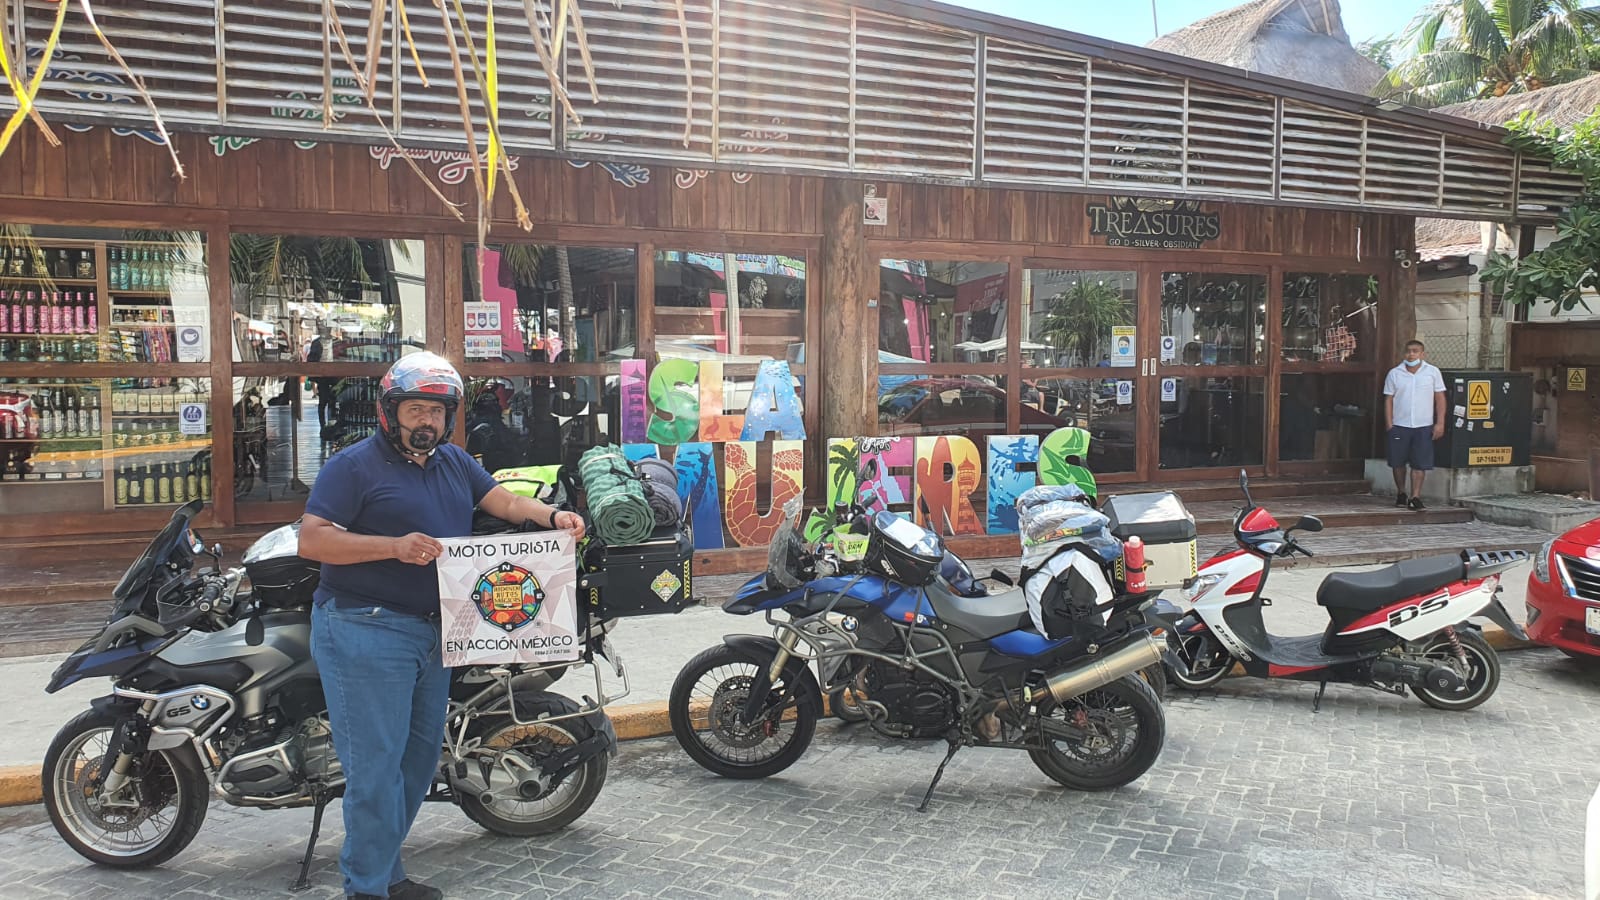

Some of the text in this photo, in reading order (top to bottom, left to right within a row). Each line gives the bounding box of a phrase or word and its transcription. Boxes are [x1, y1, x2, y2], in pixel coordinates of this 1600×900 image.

[1089, 206, 1218, 241] TREASURES
[1134, 239, 1159, 247] SILVER
[1163, 240, 1198, 249] OBSIDIAN
[620, 358, 807, 445] ISLA
[448, 540, 561, 558] MOTO TURISTA
[1388, 593, 1449, 628] DS
[446, 635, 573, 652] EN ACCIÓN MÉXICO
[166, 705, 191, 718] GS
